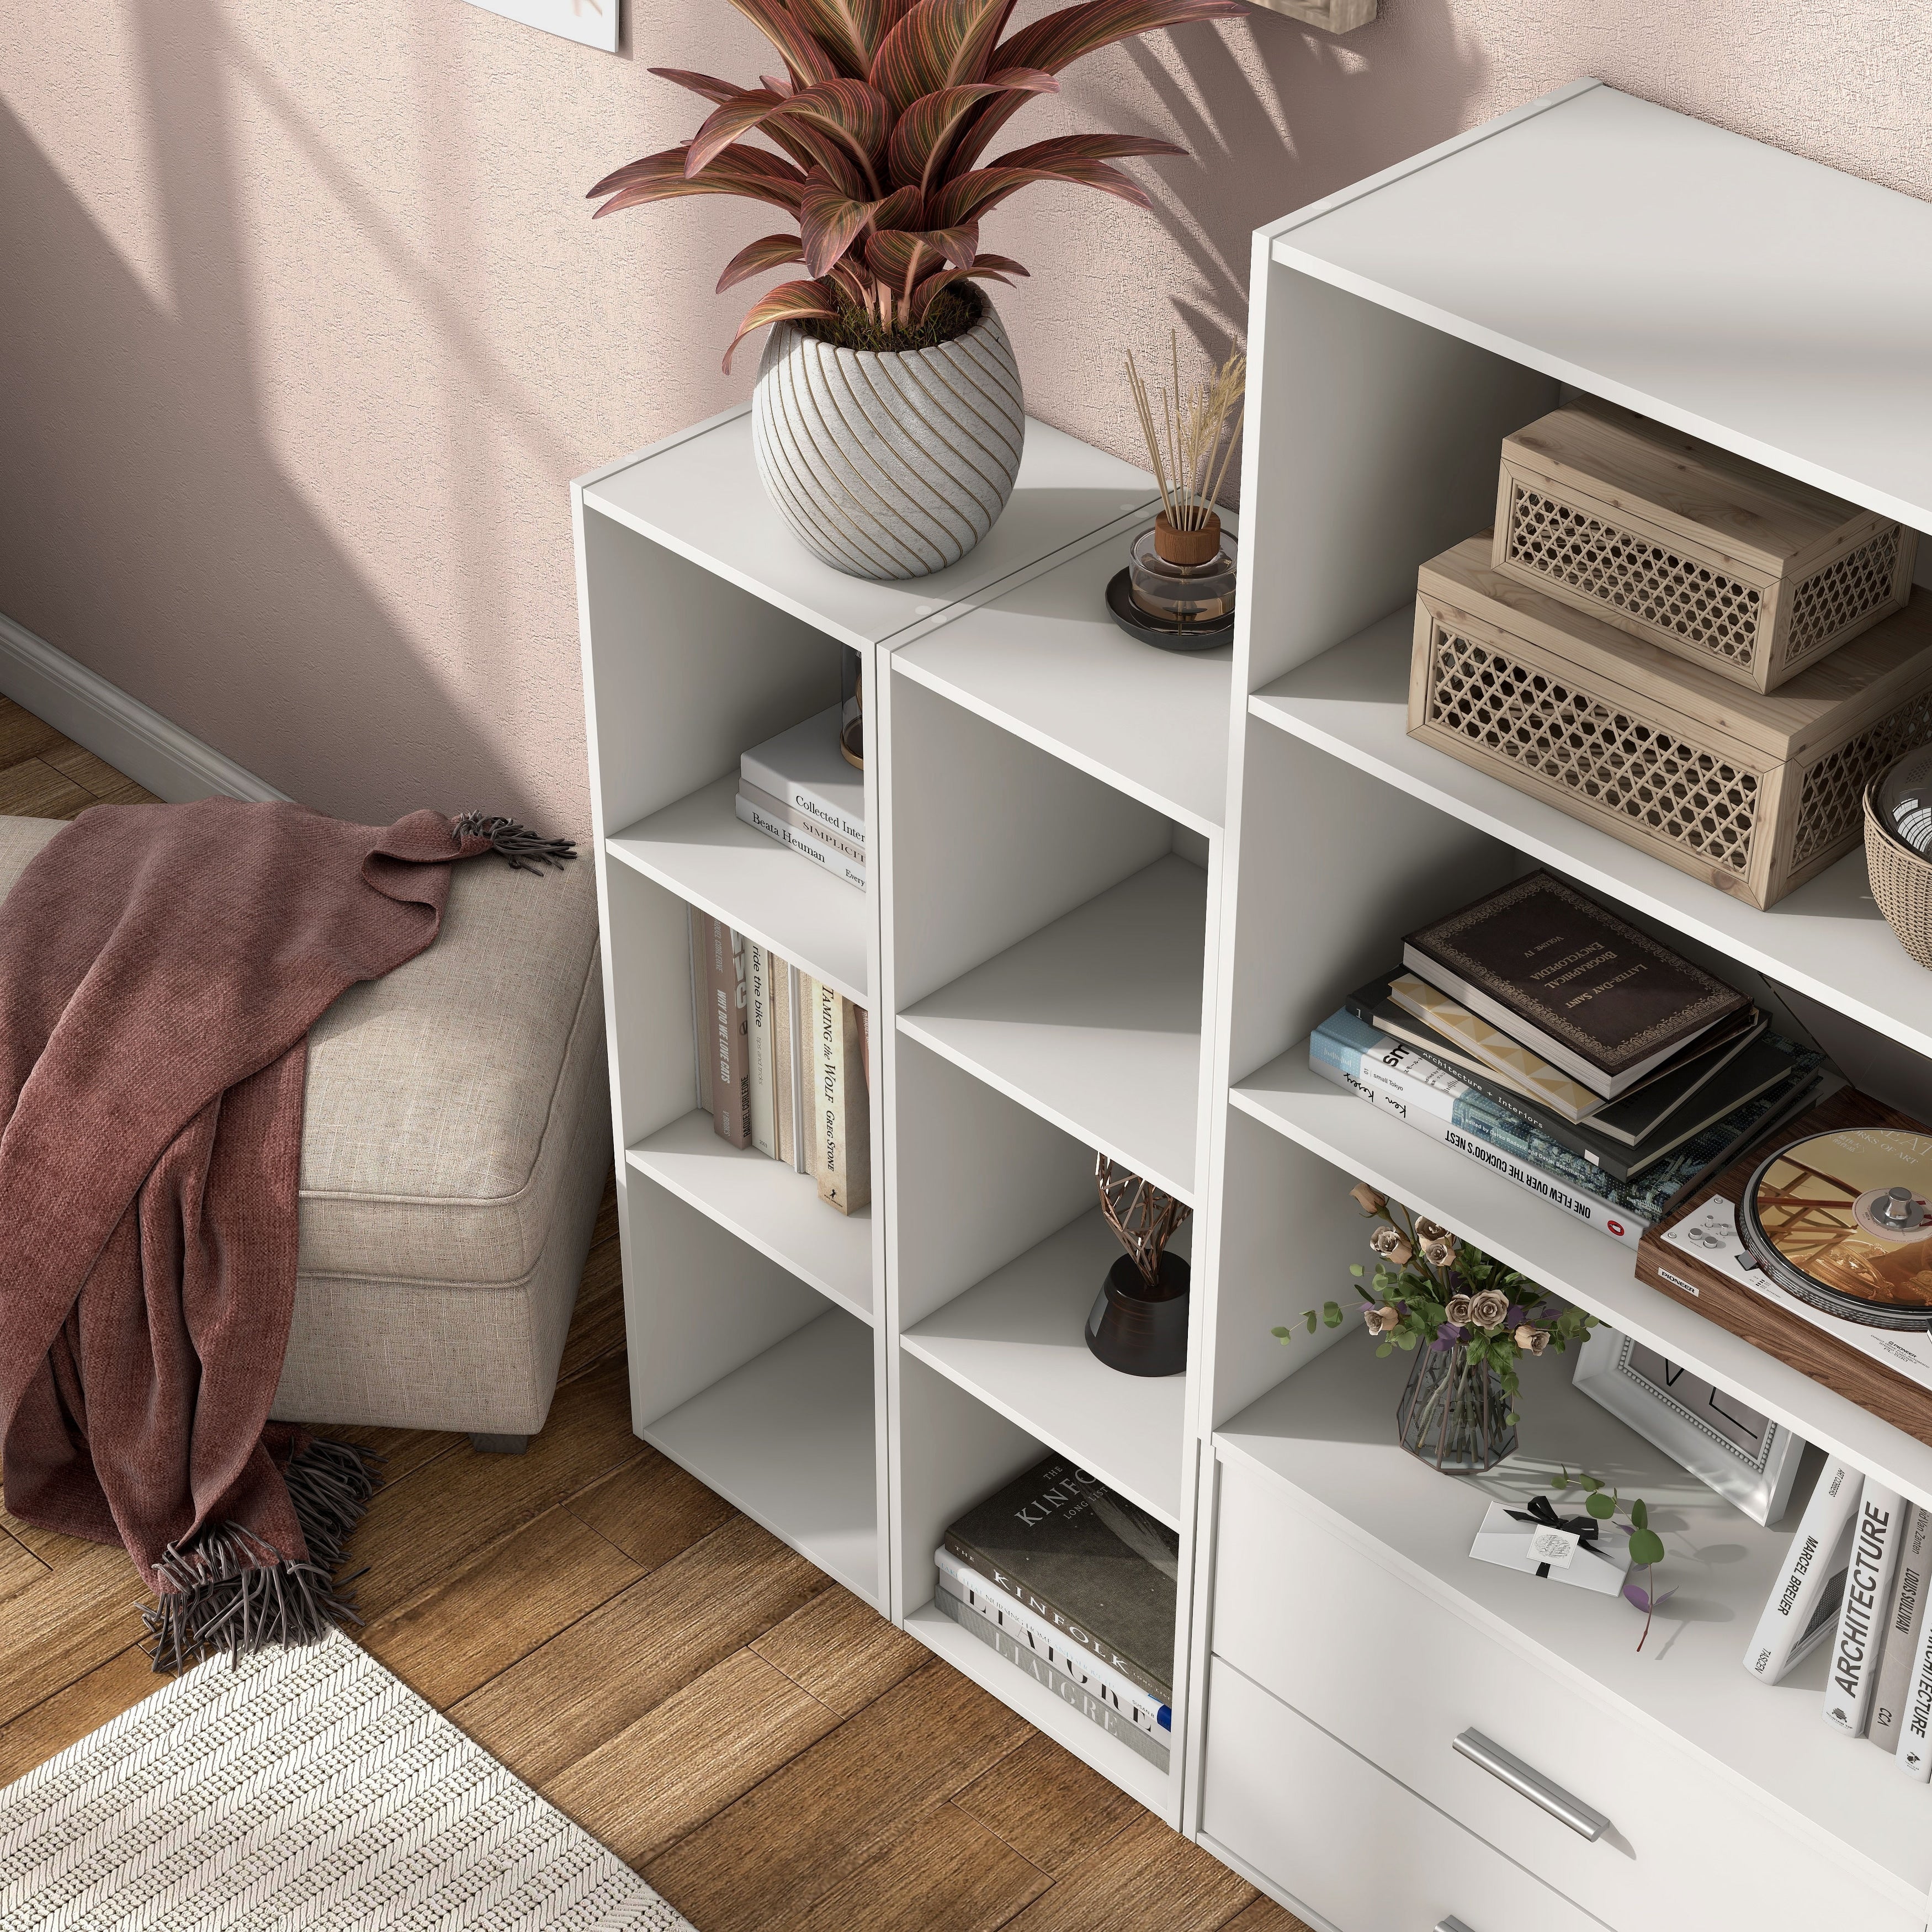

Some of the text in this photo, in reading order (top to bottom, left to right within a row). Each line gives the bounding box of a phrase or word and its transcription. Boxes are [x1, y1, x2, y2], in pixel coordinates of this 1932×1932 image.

[796, 795, 840, 828] Collected
[752, 812, 825, 863] Beata Heuman
[846, 868, 865, 887] Every
[1535, 936, 1565, 952] VOLUME
[753, 946, 761, 972] ride
[1529, 941, 1605, 980] ENCYCLOPEDIA
[1544, 951, 1618, 989] BIOGRAPHICAL
[1565, 992, 1593, 1009] SAINT
[755, 1000, 763, 1027] bike
[1356, 1009, 1362, 1020] 1
[717, 989, 730, 1084] WHY DO WE LOVE CATS
[822, 985, 836, 1103] TAMING the WOLF
[1373, 1074, 1404, 1091] small Tokyo
[741, 1075, 751, 1138] RAQUEL CORLEONE
[1344, 1073, 1406, 1118] Ken Kesey
[1498, 1097, 1543, 1129] Interiors
[826, 1110, 836, 1172] GREG STONE
[1445, 1130, 1466, 1150] NEST
[1466, 1118, 1482, 1129] edited
[1483, 1124, 1489, 1133] by
[1490, 1128, 1506, 1141] Darko
[1528, 1147, 1538, 1156] and
[1539, 1153, 1554, 1165] Davisi
[1556, 1161, 1585, 1180] Boontharm
[1881, 1144, 1897, 1152] OF
[1895, 1152, 1919, 1165] ART
[1509, 1164, 1524, 1183] THE
[1526, 1174, 1548, 1195] OVER
[1549, 1187, 1572, 1209] FLEW
[1637, 1202, 1652, 1211] studio
[1574, 1200, 1591, 1219] ONE
[1662, 1271, 1695, 1293] PIONEER
[1871, 1335, 1885, 1343] DIRECT
[1908, 1355, 1930, 1368] AUTOMATIC
[1879, 1342, 1917, 1364] STEREO TURNTABLE
[1893, 1344, 1917, 1357] PIONEER
[1043, 1466, 1063, 1480] THE
[1837, 1467, 1845, 1480] ART
[1063, 1501, 1089, 1520] LONG
[1917, 1519, 1928, 1532] Van
[1912, 1531, 1925, 1554] Zanten
[1777, 1535, 1819, 1616] MARCEL BREUER
[1835, 1501, 1889, 1699] ARCHITECTURE
[1896, 1567, 1920, 1634] LOUIS SULLIVAN
[954, 1545, 1171, 1701] THE KINFOLK LONG LIST
[1754, 1648, 1771, 1674] TASCEN
[1132, 1700, 1150, 1715] SUSAN
[1877, 1707, 1892, 1727] CCA
[1826, 1712, 1844, 1726] MOUNTAIN
